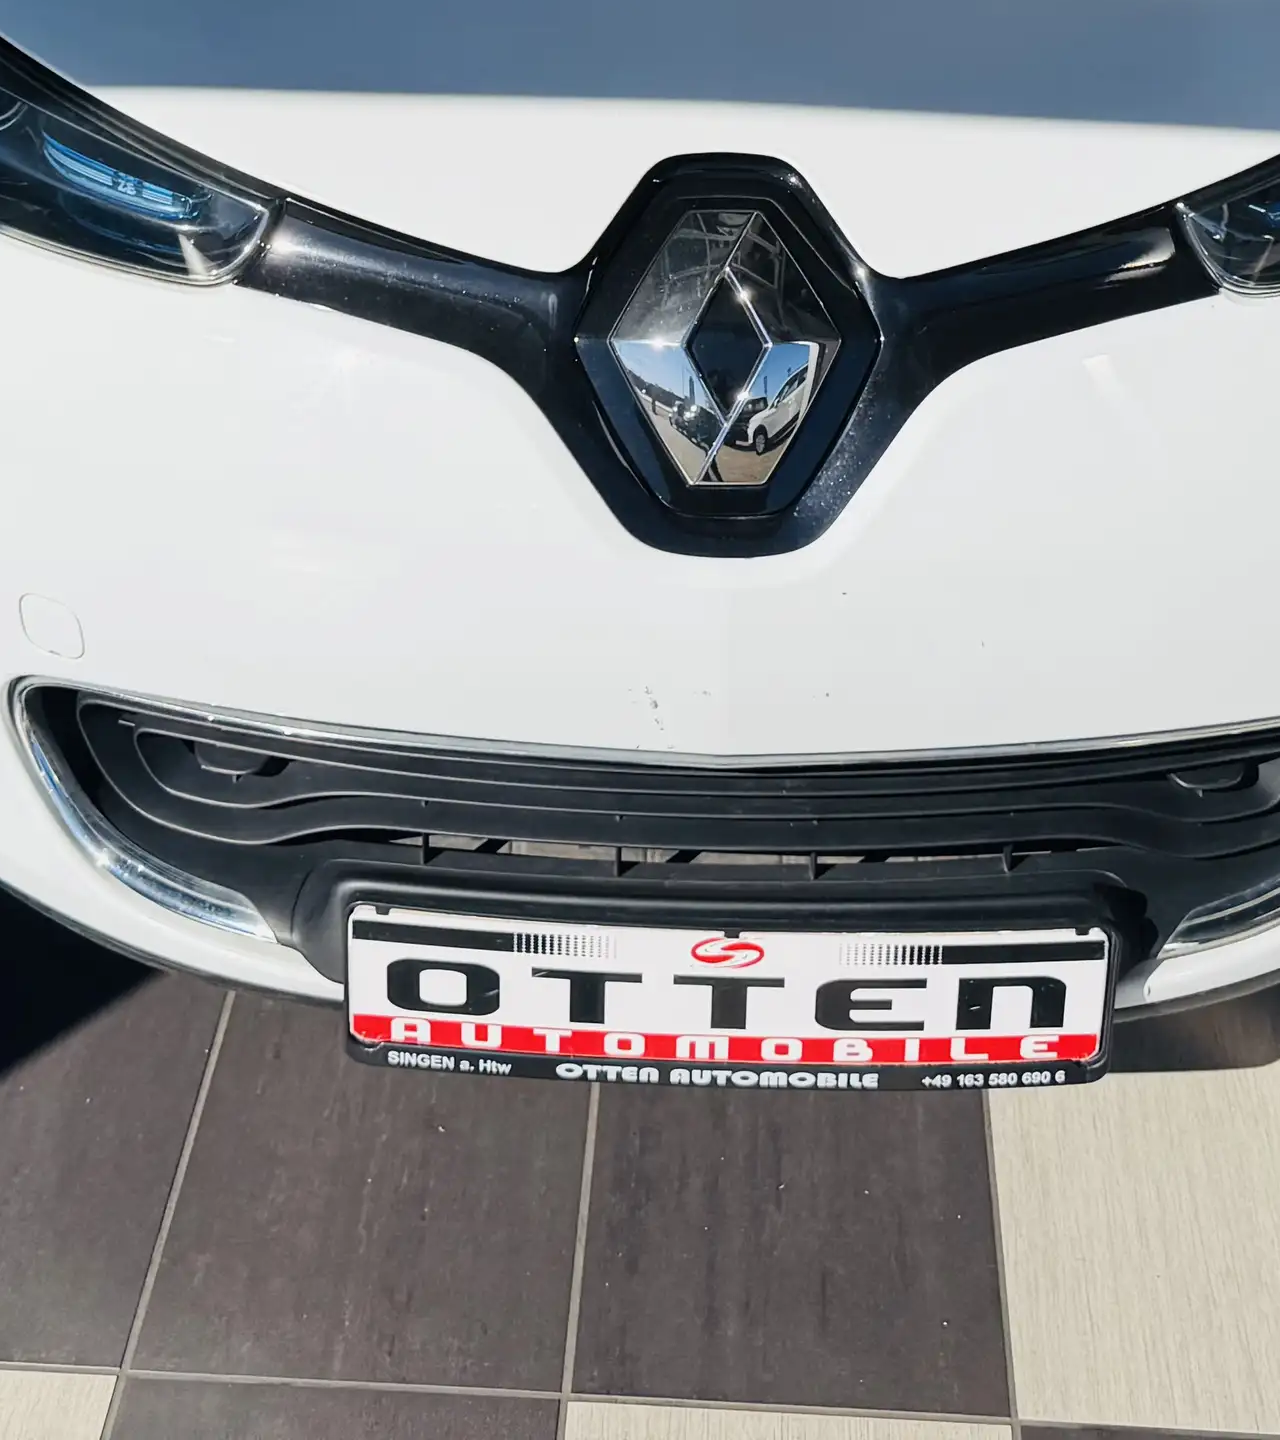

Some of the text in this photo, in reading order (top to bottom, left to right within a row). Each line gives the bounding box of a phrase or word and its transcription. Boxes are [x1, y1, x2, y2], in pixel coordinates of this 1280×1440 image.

[386, 958, 1067, 1031] OTTEN
[389, 1016, 1060, 1062] AUTOMOBILE
[387, 1050, 455, 1071] SINGEN
[478, 1058, 512, 1075] Htw
[555, 1062, 880, 1089] OTTEN AUTOMOBILE
[921, 1070, 1066, 1088] +49 163 580 690 6
